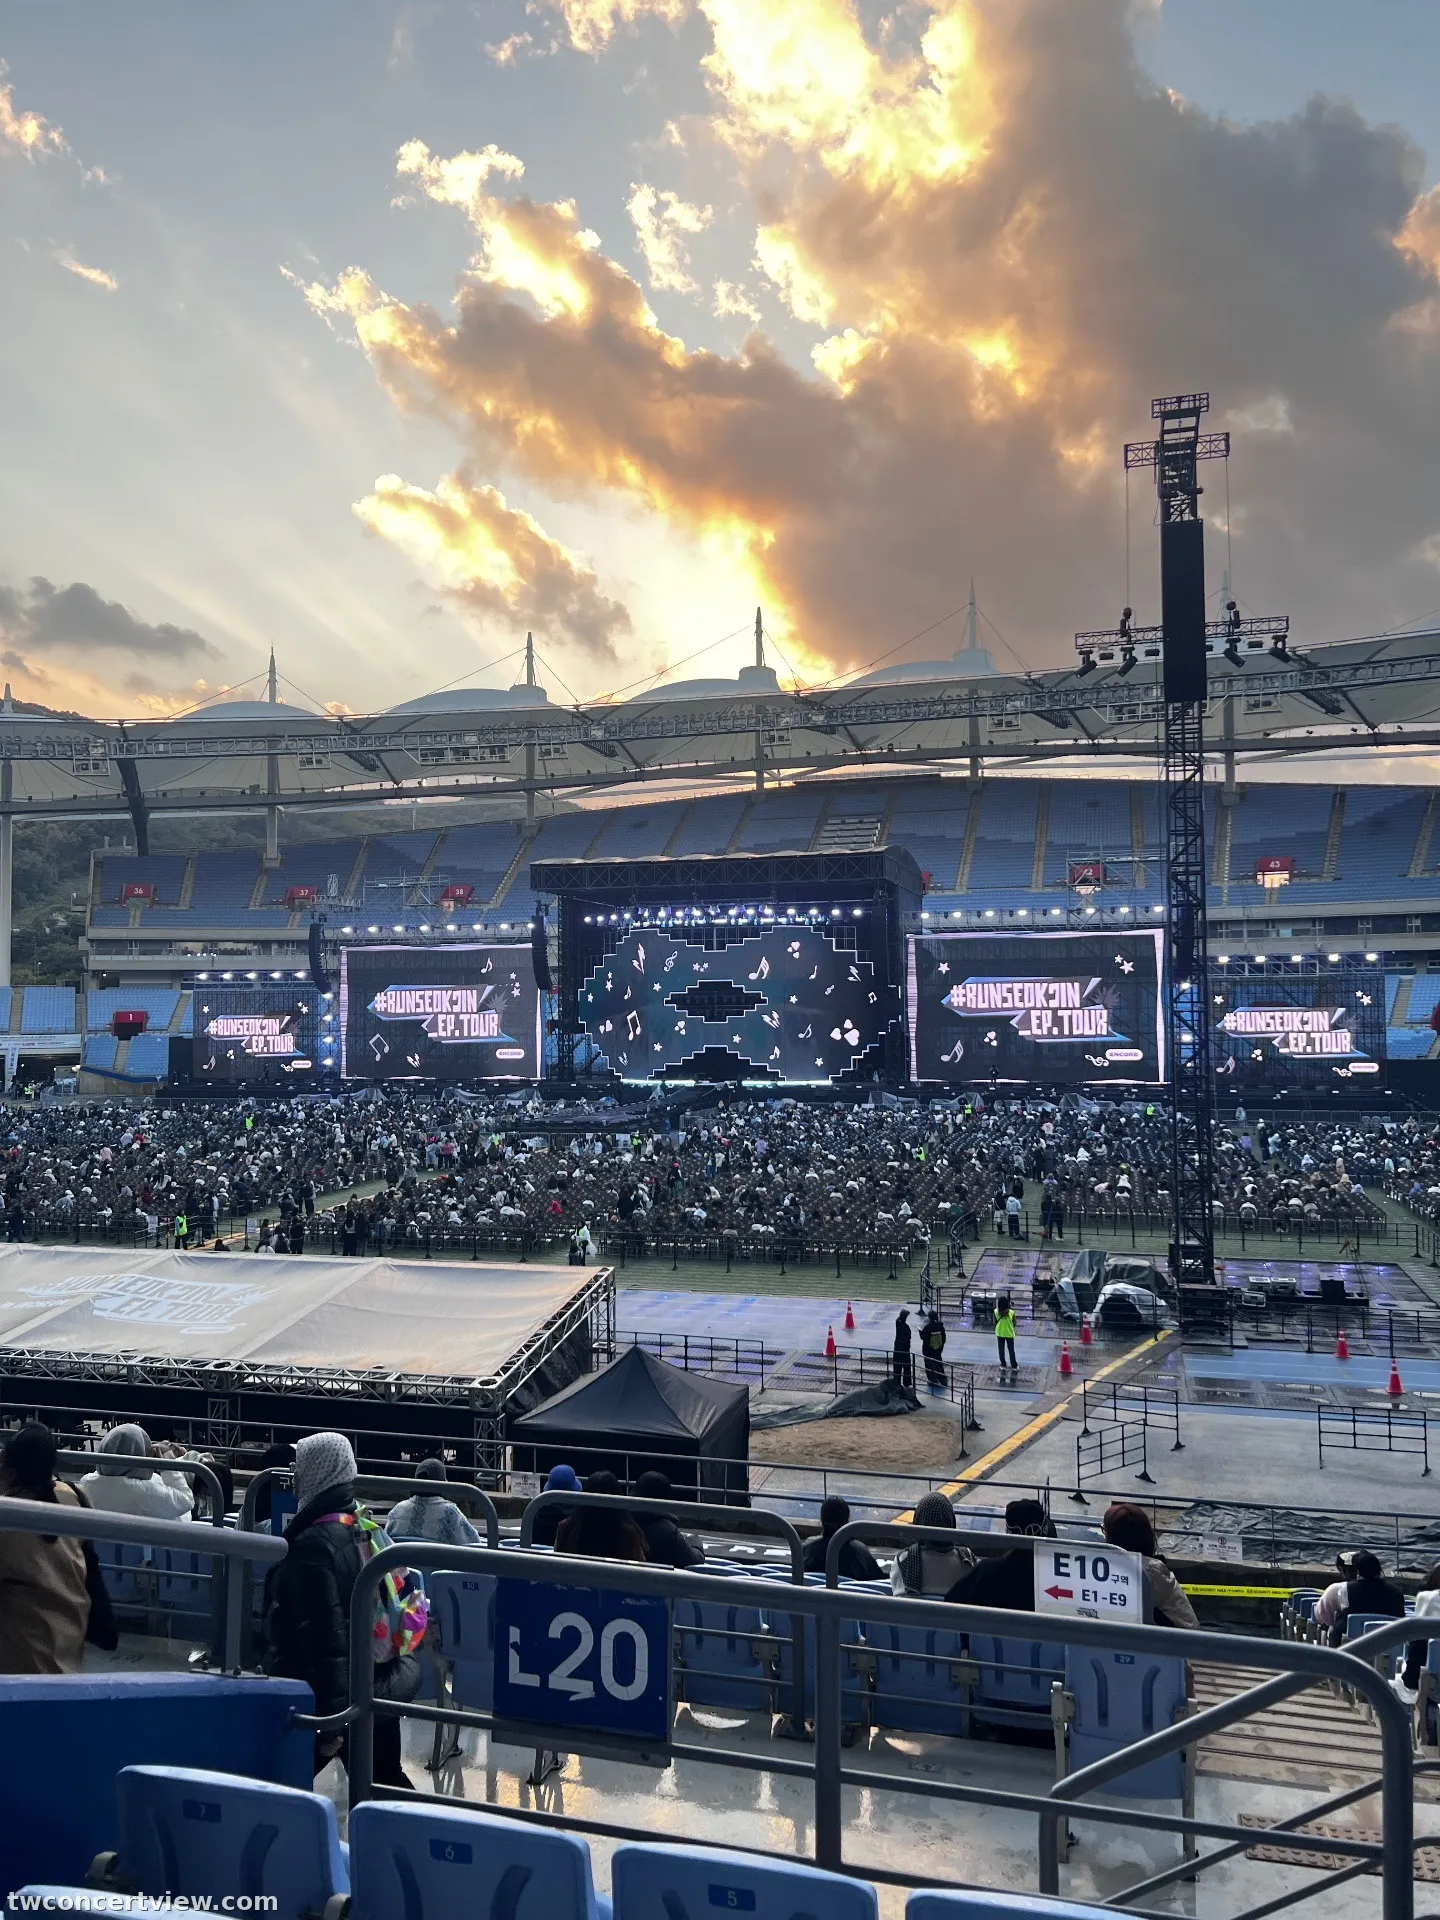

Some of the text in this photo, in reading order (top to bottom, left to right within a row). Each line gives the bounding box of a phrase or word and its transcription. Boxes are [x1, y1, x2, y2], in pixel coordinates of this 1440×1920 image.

[1269, 860, 1281, 868] 43
[133, 887, 144, 895] 36
[129, 1013, 133, 1021] 1
[1053, 1552, 1129, 1586] E10 구역
[508, 1612, 649, 1701] L20
[1120, 1655, 1130, 1663] 29
[445, 1845, 455, 1860] 6
[727, 1890, 737, 1907] 5
